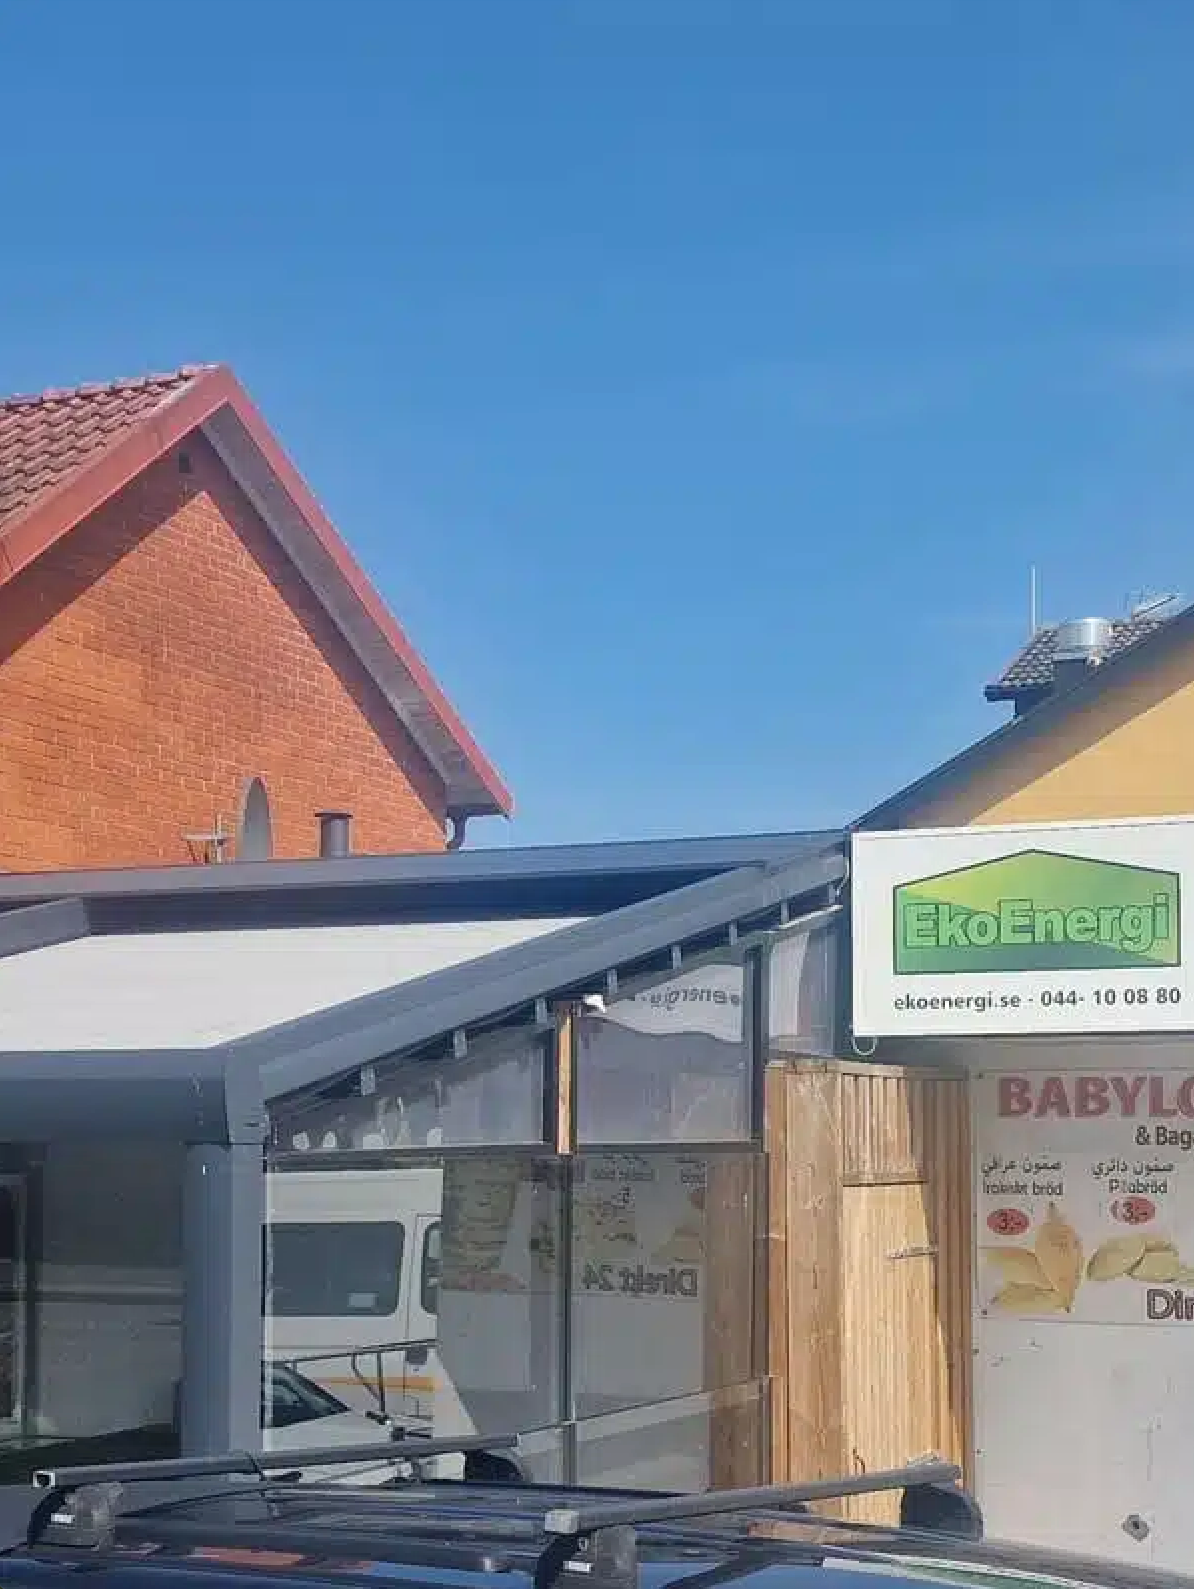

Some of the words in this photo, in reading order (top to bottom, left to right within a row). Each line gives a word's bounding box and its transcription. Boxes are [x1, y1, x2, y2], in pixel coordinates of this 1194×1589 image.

[903, 892, 1171, 955] EkoEnergi
[894, 992, 1020, 1013] ekoenergi.se
[1093, 989, 1117, 1006] 10
[1123, 988, 1148, 1005] 08
[1156, 986, 1182, 1004] 80
[1135, 1125, 1151, 1146] &
